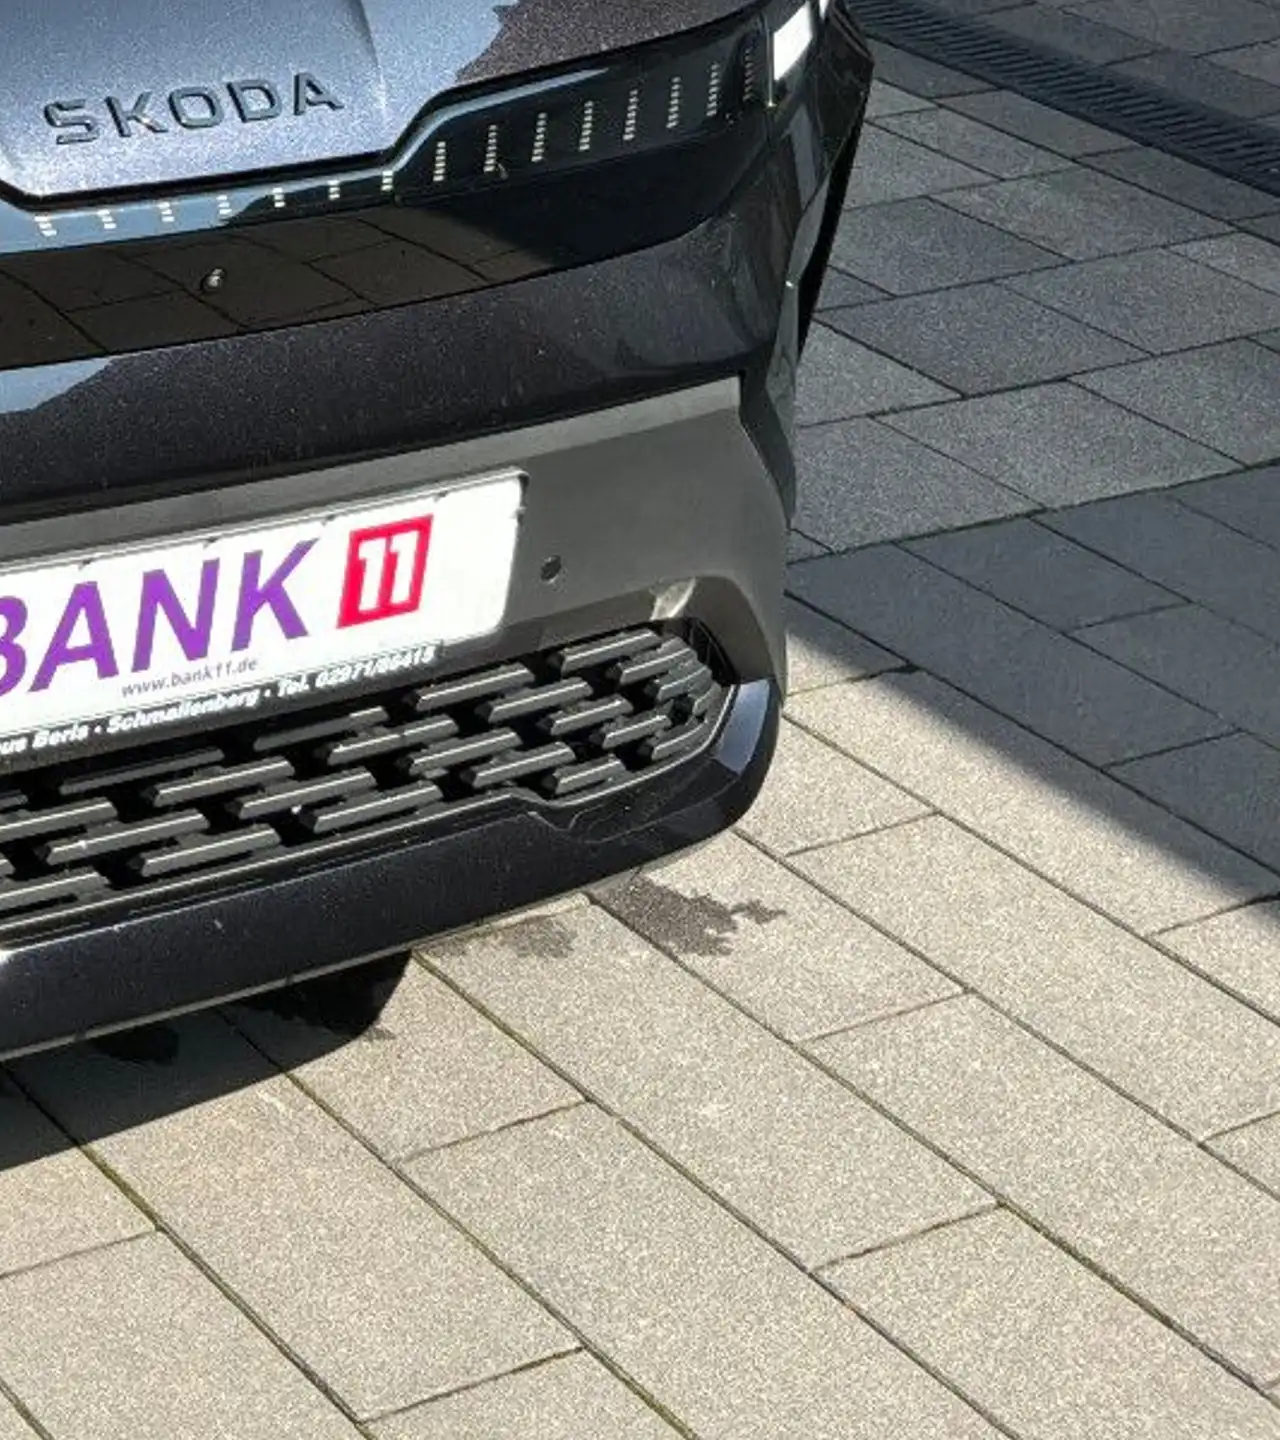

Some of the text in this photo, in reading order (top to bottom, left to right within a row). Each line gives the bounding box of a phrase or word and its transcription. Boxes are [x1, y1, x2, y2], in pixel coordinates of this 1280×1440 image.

[355, 528, 422, 613] 11
[106, 688, 261, 734] Schmallenberg
[277, 672, 310, 698] Tel.
[121, 656, 258, 698] www.bank11.de
